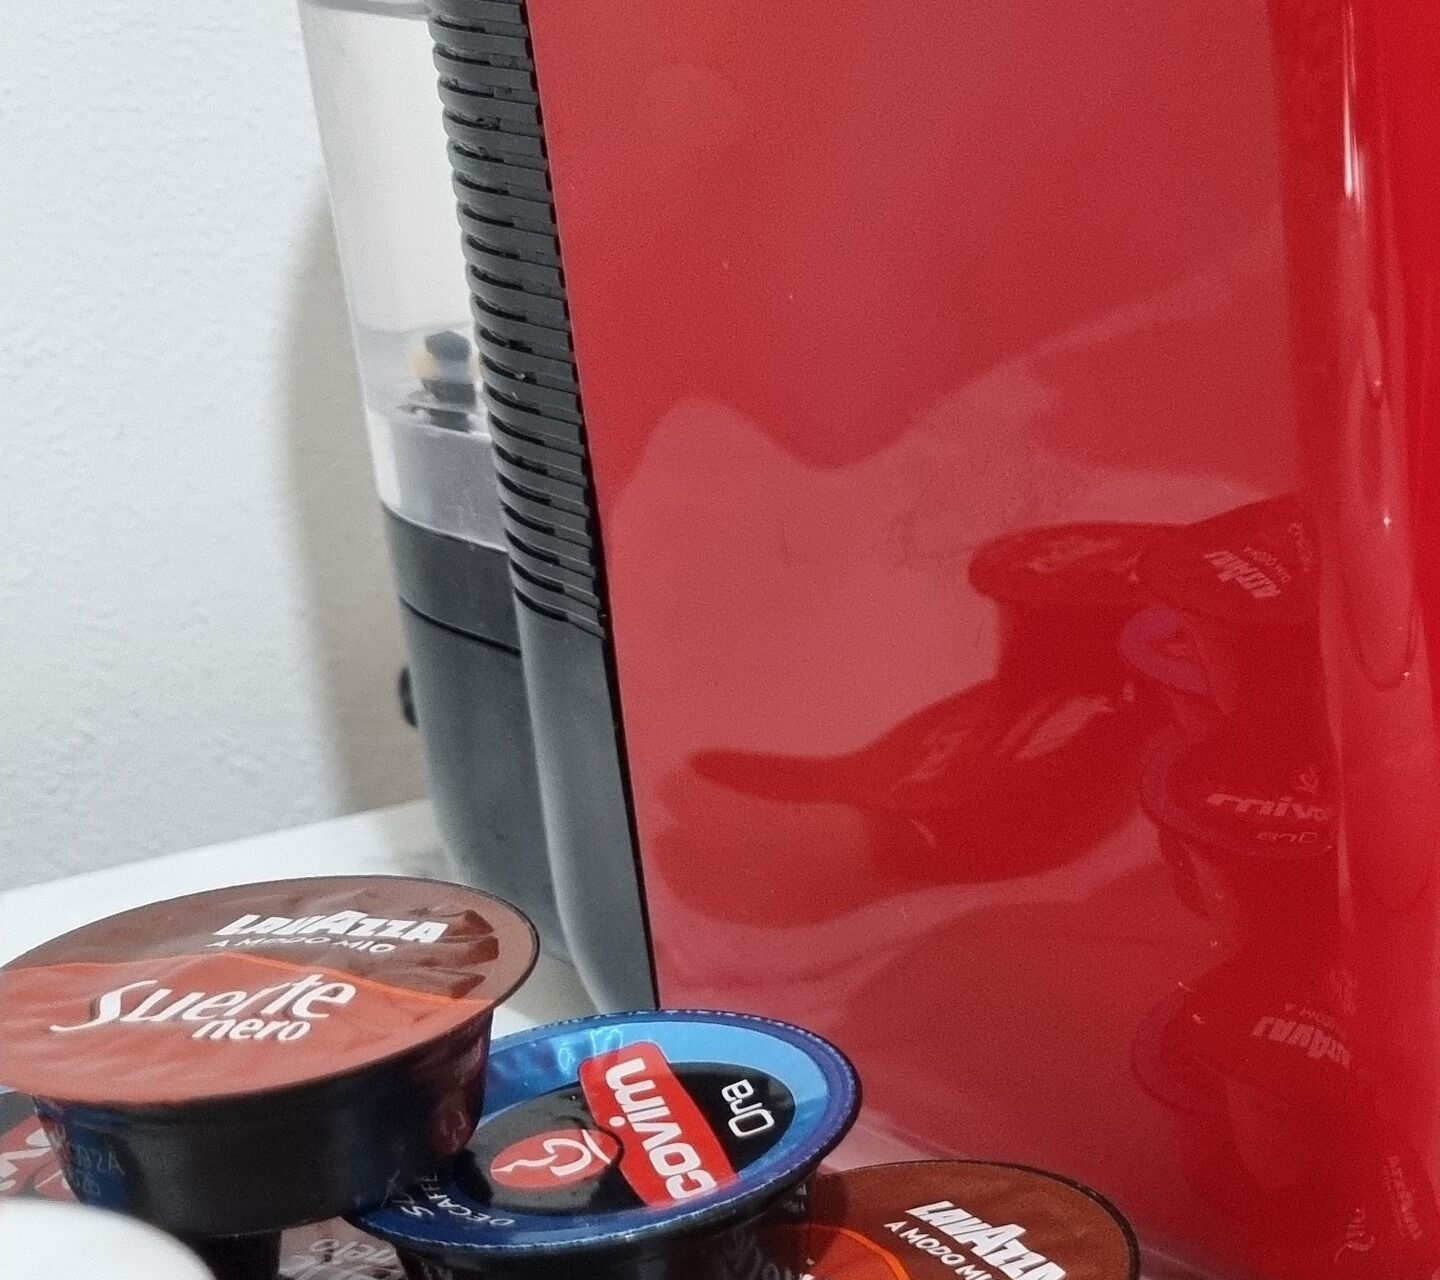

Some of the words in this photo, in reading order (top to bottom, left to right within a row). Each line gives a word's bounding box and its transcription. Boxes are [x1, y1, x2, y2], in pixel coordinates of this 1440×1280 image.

[206, 939, 230, 948] A
[236, 935, 332, 947] MODO
[334, 938, 398, 953] MIO
[213, 910, 449, 943] LAVAZZA
[50, 973, 357, 1032] Suerte
[192, 1018, 312, 1042] nero
[605, 1057, 718, 1200] covim
[721, 1079, 776, 1138] Ora
[883, 1221, 907, 1233] A
[899, 1227, 967, 1268] MODO
